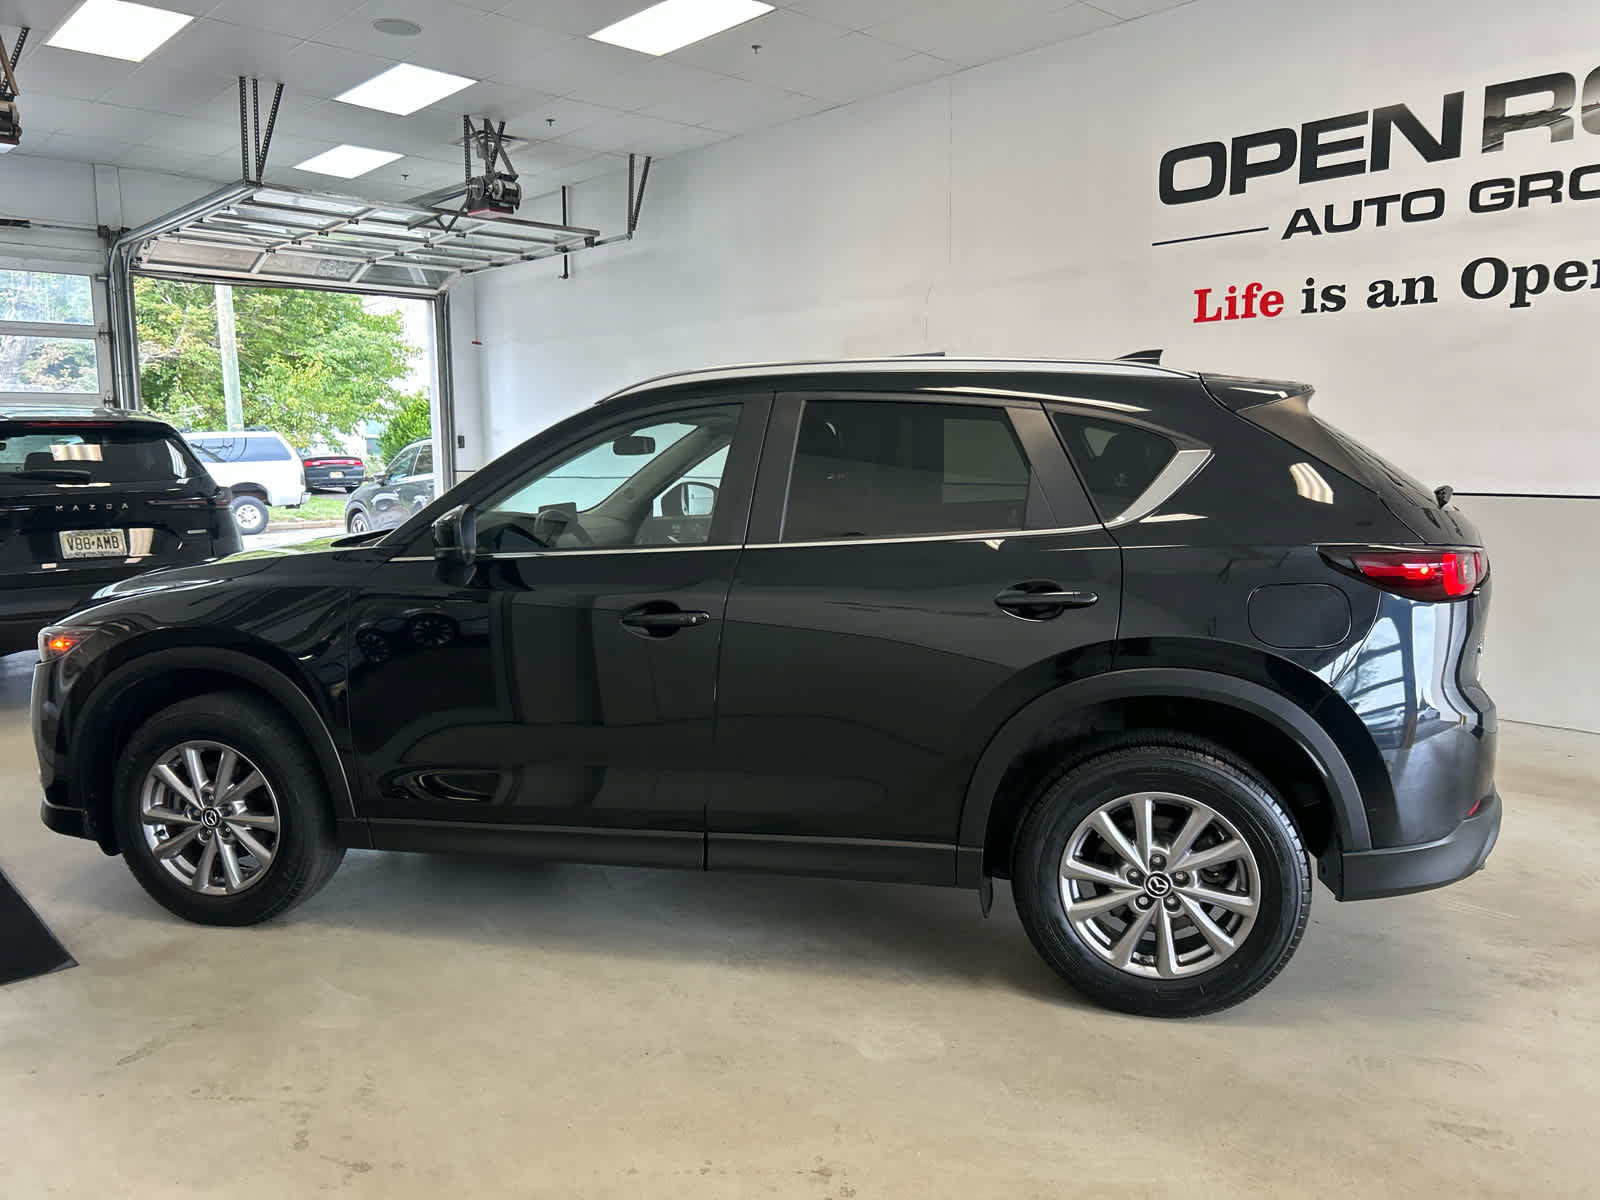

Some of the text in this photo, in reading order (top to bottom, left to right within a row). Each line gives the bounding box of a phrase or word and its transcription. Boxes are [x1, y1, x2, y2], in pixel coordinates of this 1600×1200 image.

[1159, 65, 1600, 205] OPEN R
[1281, 188, 1445, 240] AUTO
[1193, 282, 1284, 323] Life
[1301, 278, 1346, 314] is
[1367, 273, 1437, 310] an
[56, 503, 128, 511] MAZDA
